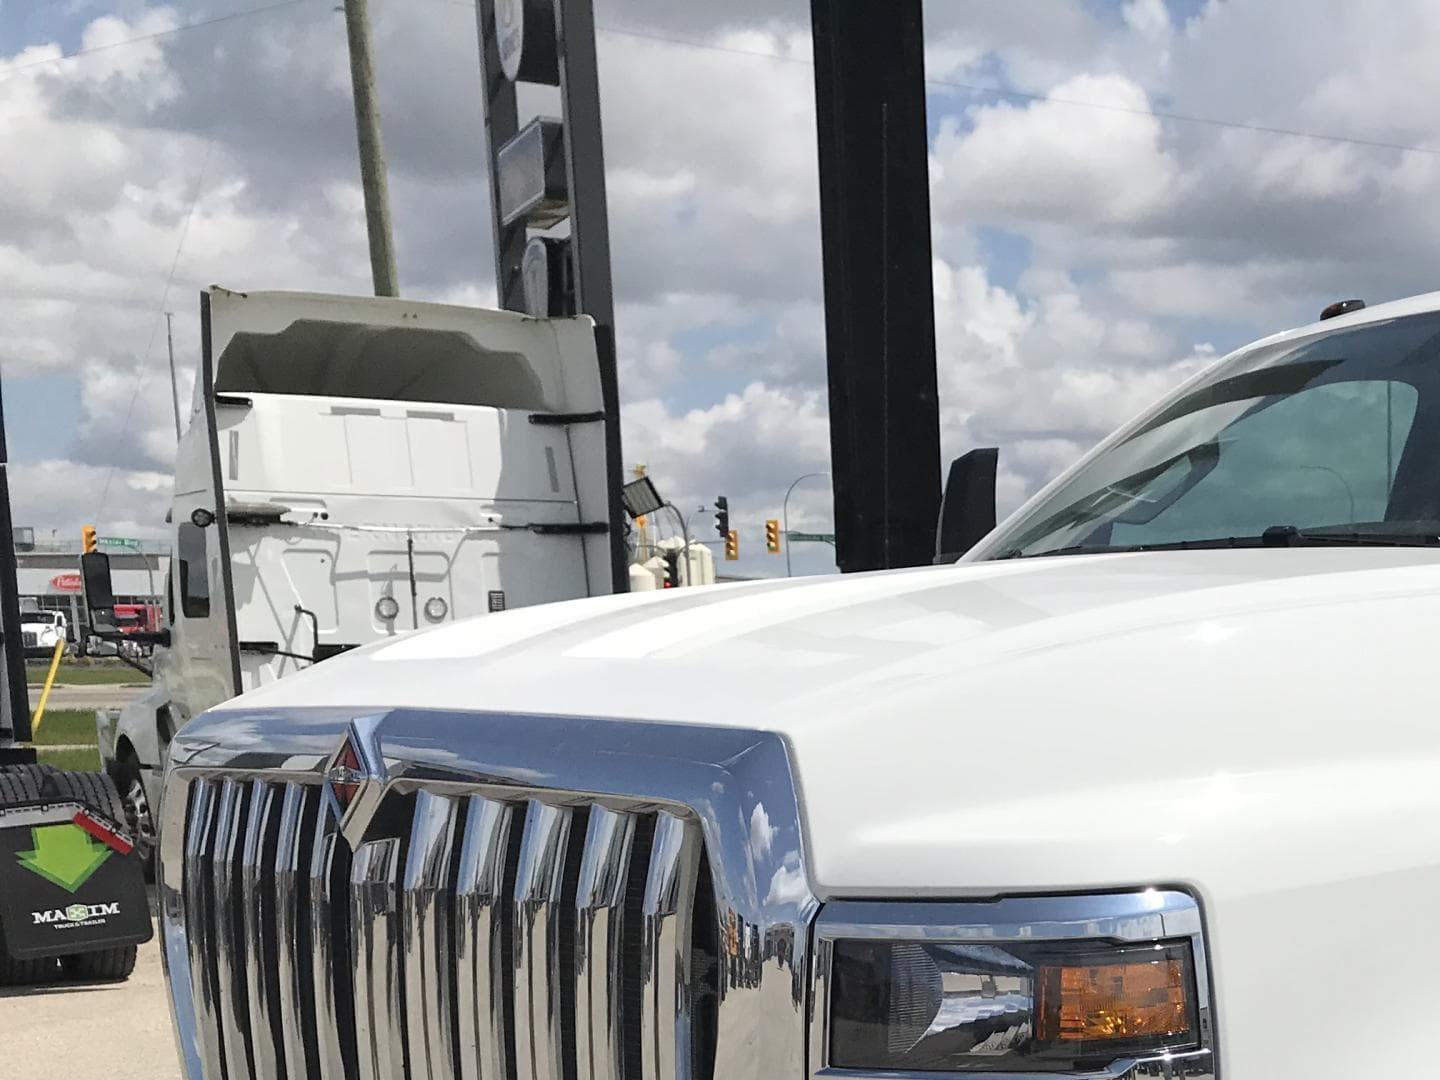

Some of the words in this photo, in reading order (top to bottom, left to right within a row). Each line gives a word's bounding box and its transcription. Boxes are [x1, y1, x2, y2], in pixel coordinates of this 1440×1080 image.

[31, 902, 121, 924] MAXIM
[54, 922, 75, 930] TRUCK
[80, 918, 106, 927] TRAILER
